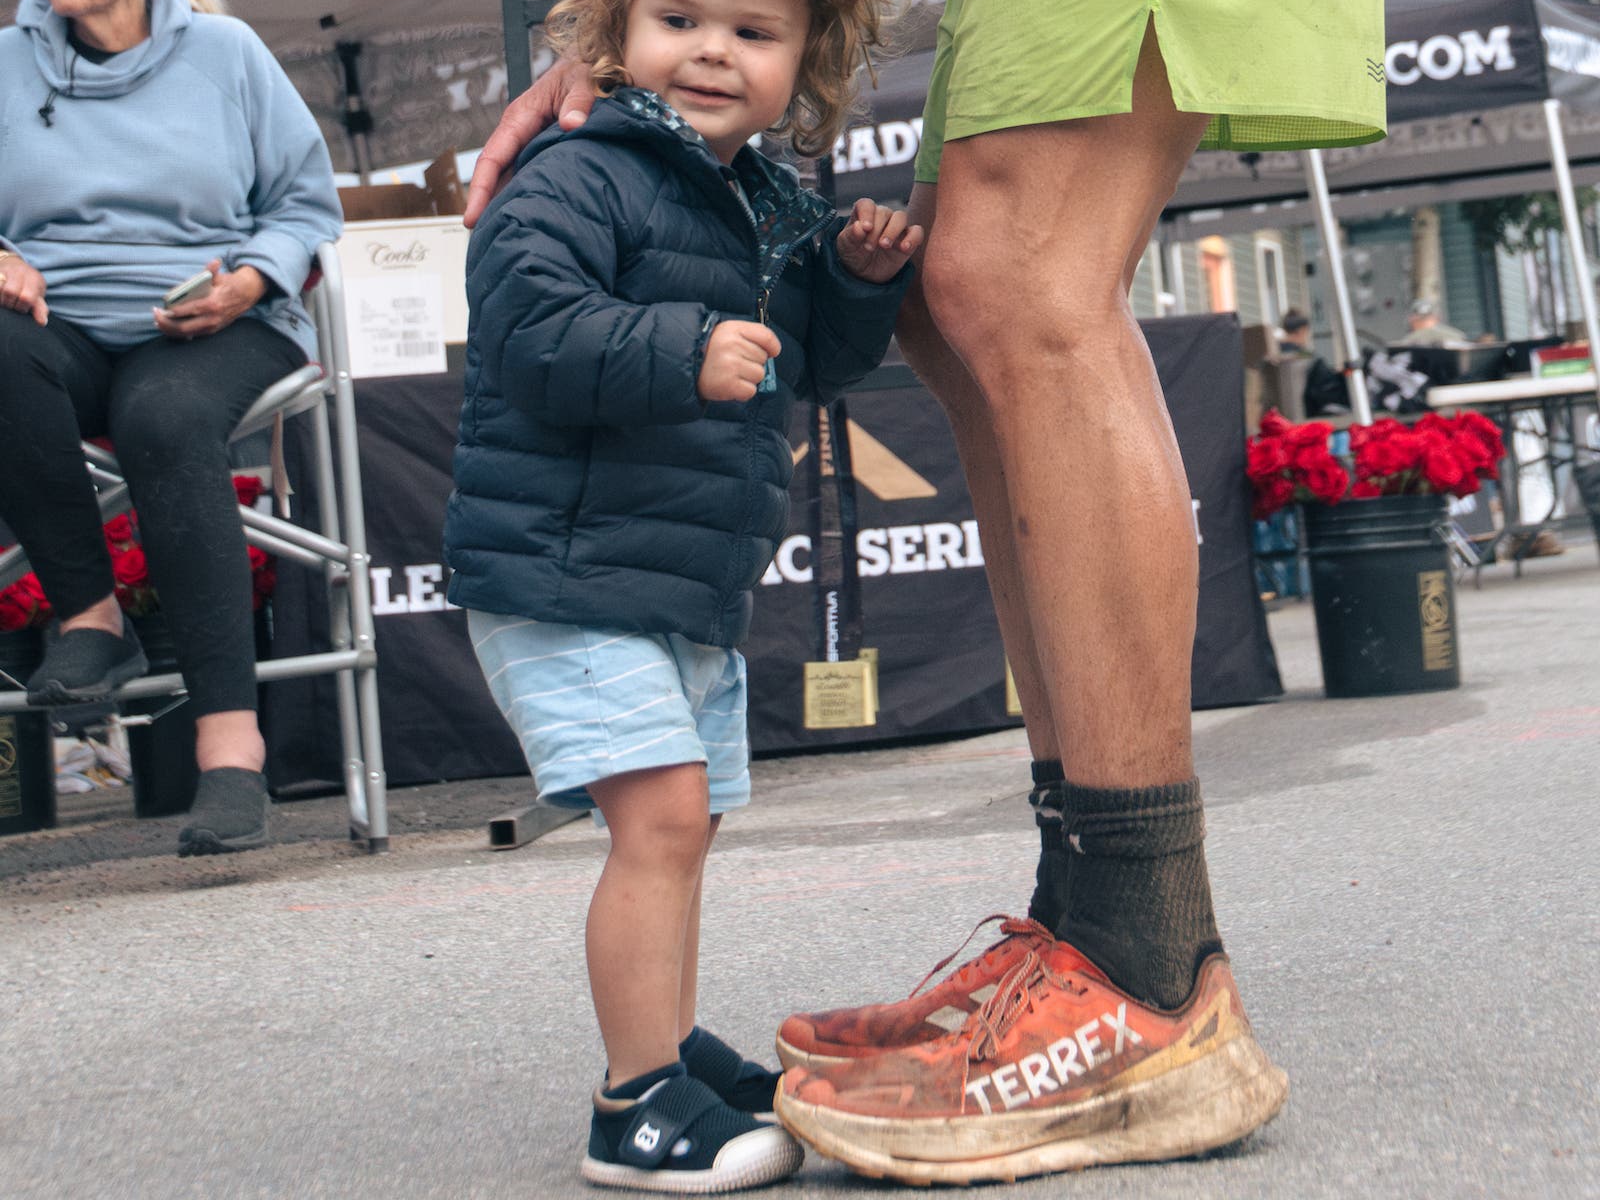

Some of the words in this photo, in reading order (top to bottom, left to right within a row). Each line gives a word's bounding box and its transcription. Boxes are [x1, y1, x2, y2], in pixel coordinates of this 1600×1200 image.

[1384, 25, 1516, 86] COM
[371, 563, 462, 616] LE
[965, 1001, 1143, 1116] TERREX
